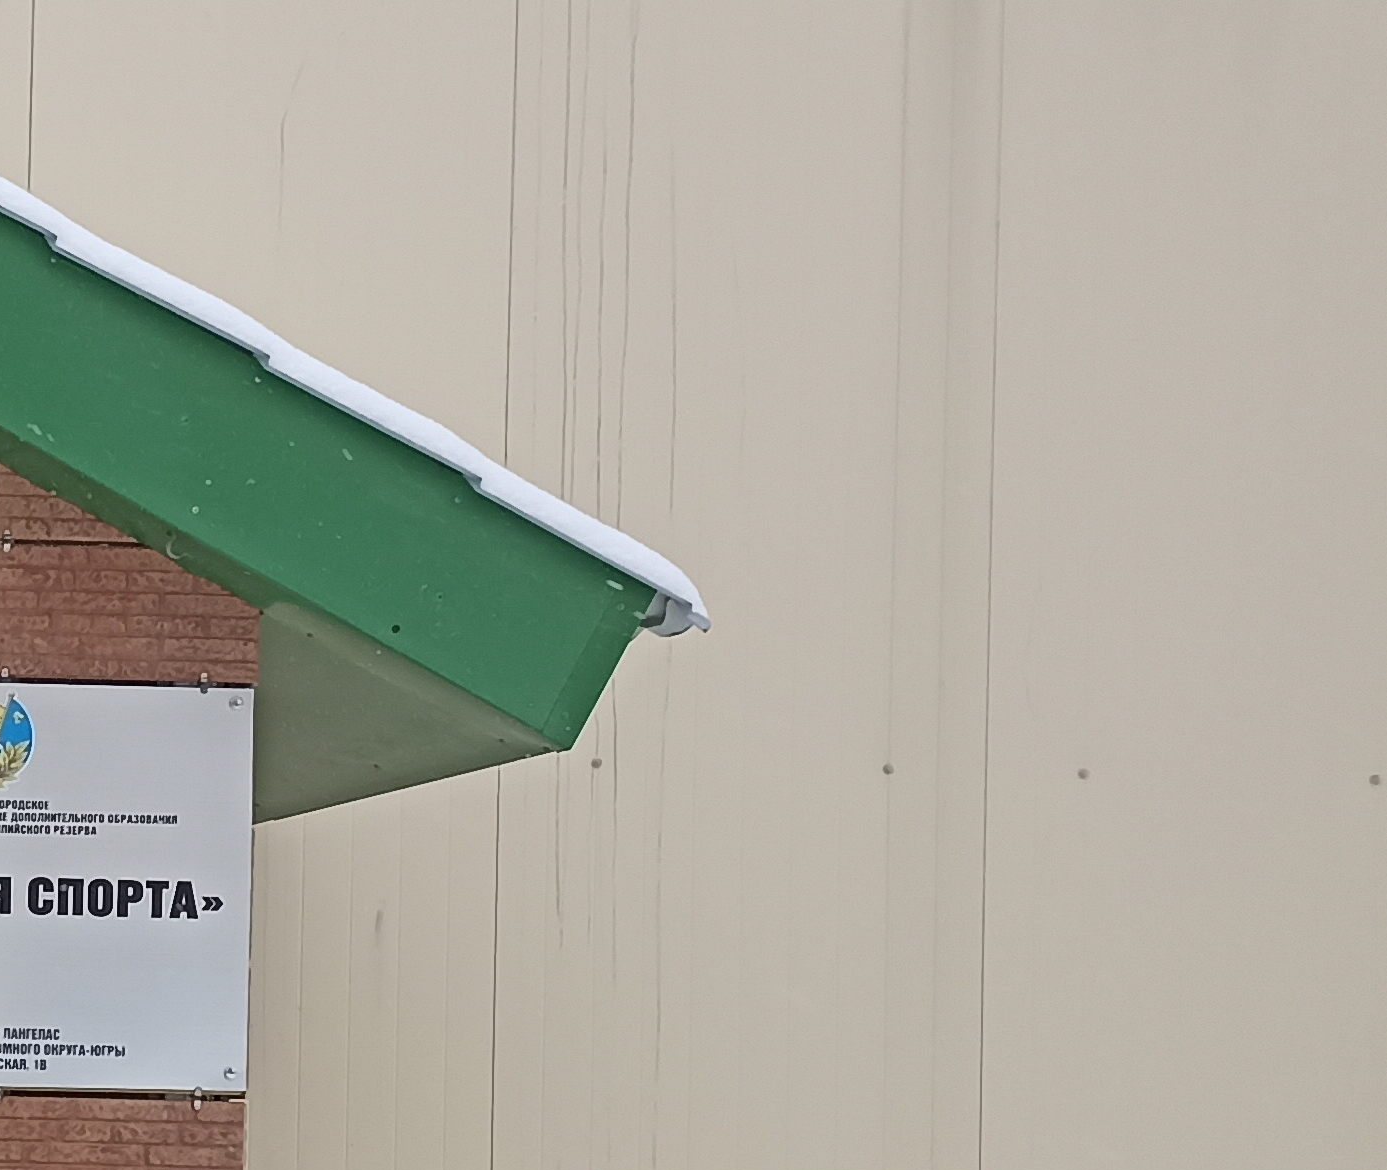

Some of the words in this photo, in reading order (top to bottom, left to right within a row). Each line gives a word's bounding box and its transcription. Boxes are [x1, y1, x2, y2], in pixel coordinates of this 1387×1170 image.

[11, 812, 105, 824] ДОПОЛНИТЕЛЬНОГО
[108, 814, 178, 825] ОБРАЗОВАНИЯ
[54, 825, 97, 836] РЕЗЕРВА
[27, 876, 224, 920] СПОРТА»
[3, 1027, 60, 1040] ЛАНГЕПАС
[43, 1043, 126, 1057] ОКРУГА-ЮГРЫ
